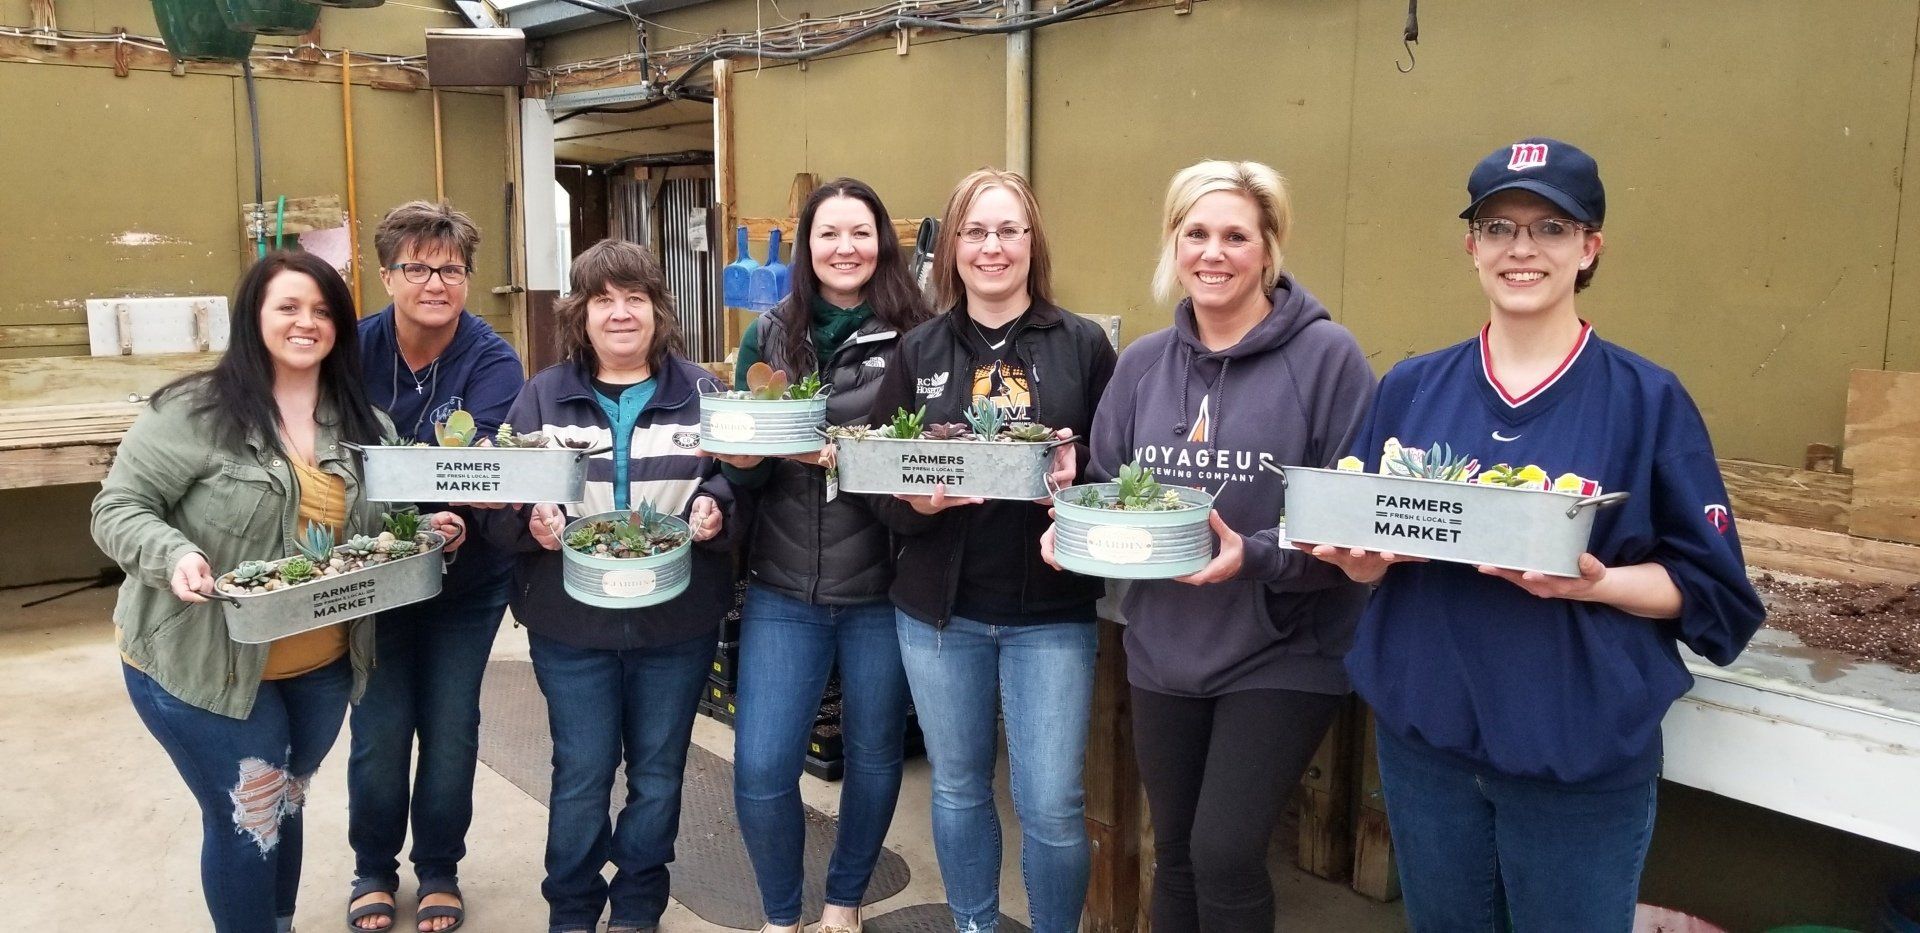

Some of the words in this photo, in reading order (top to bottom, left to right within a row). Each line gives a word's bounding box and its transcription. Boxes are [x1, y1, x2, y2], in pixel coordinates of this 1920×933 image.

[917, 377, 931, 386] RC
[902, 454, 965, 465] FARMERS
[436, 461, 501, 472] FARMERS
[902, 473, 965, 486] MARKET
[1198, 471, 1255, 483] COMPANY
[436, 481, 501, 491] MARKET
[1375, 494, 1463, 515] FARMERS
[1389, 512, 1414, 520] FRESH
[1422, 516, 1447, 524] LOCAL
[1374, 521, 1462, 543] MARKET
[313, 578, 376, 602] FARMERS
[313, 595, 376, 619] MARKET
